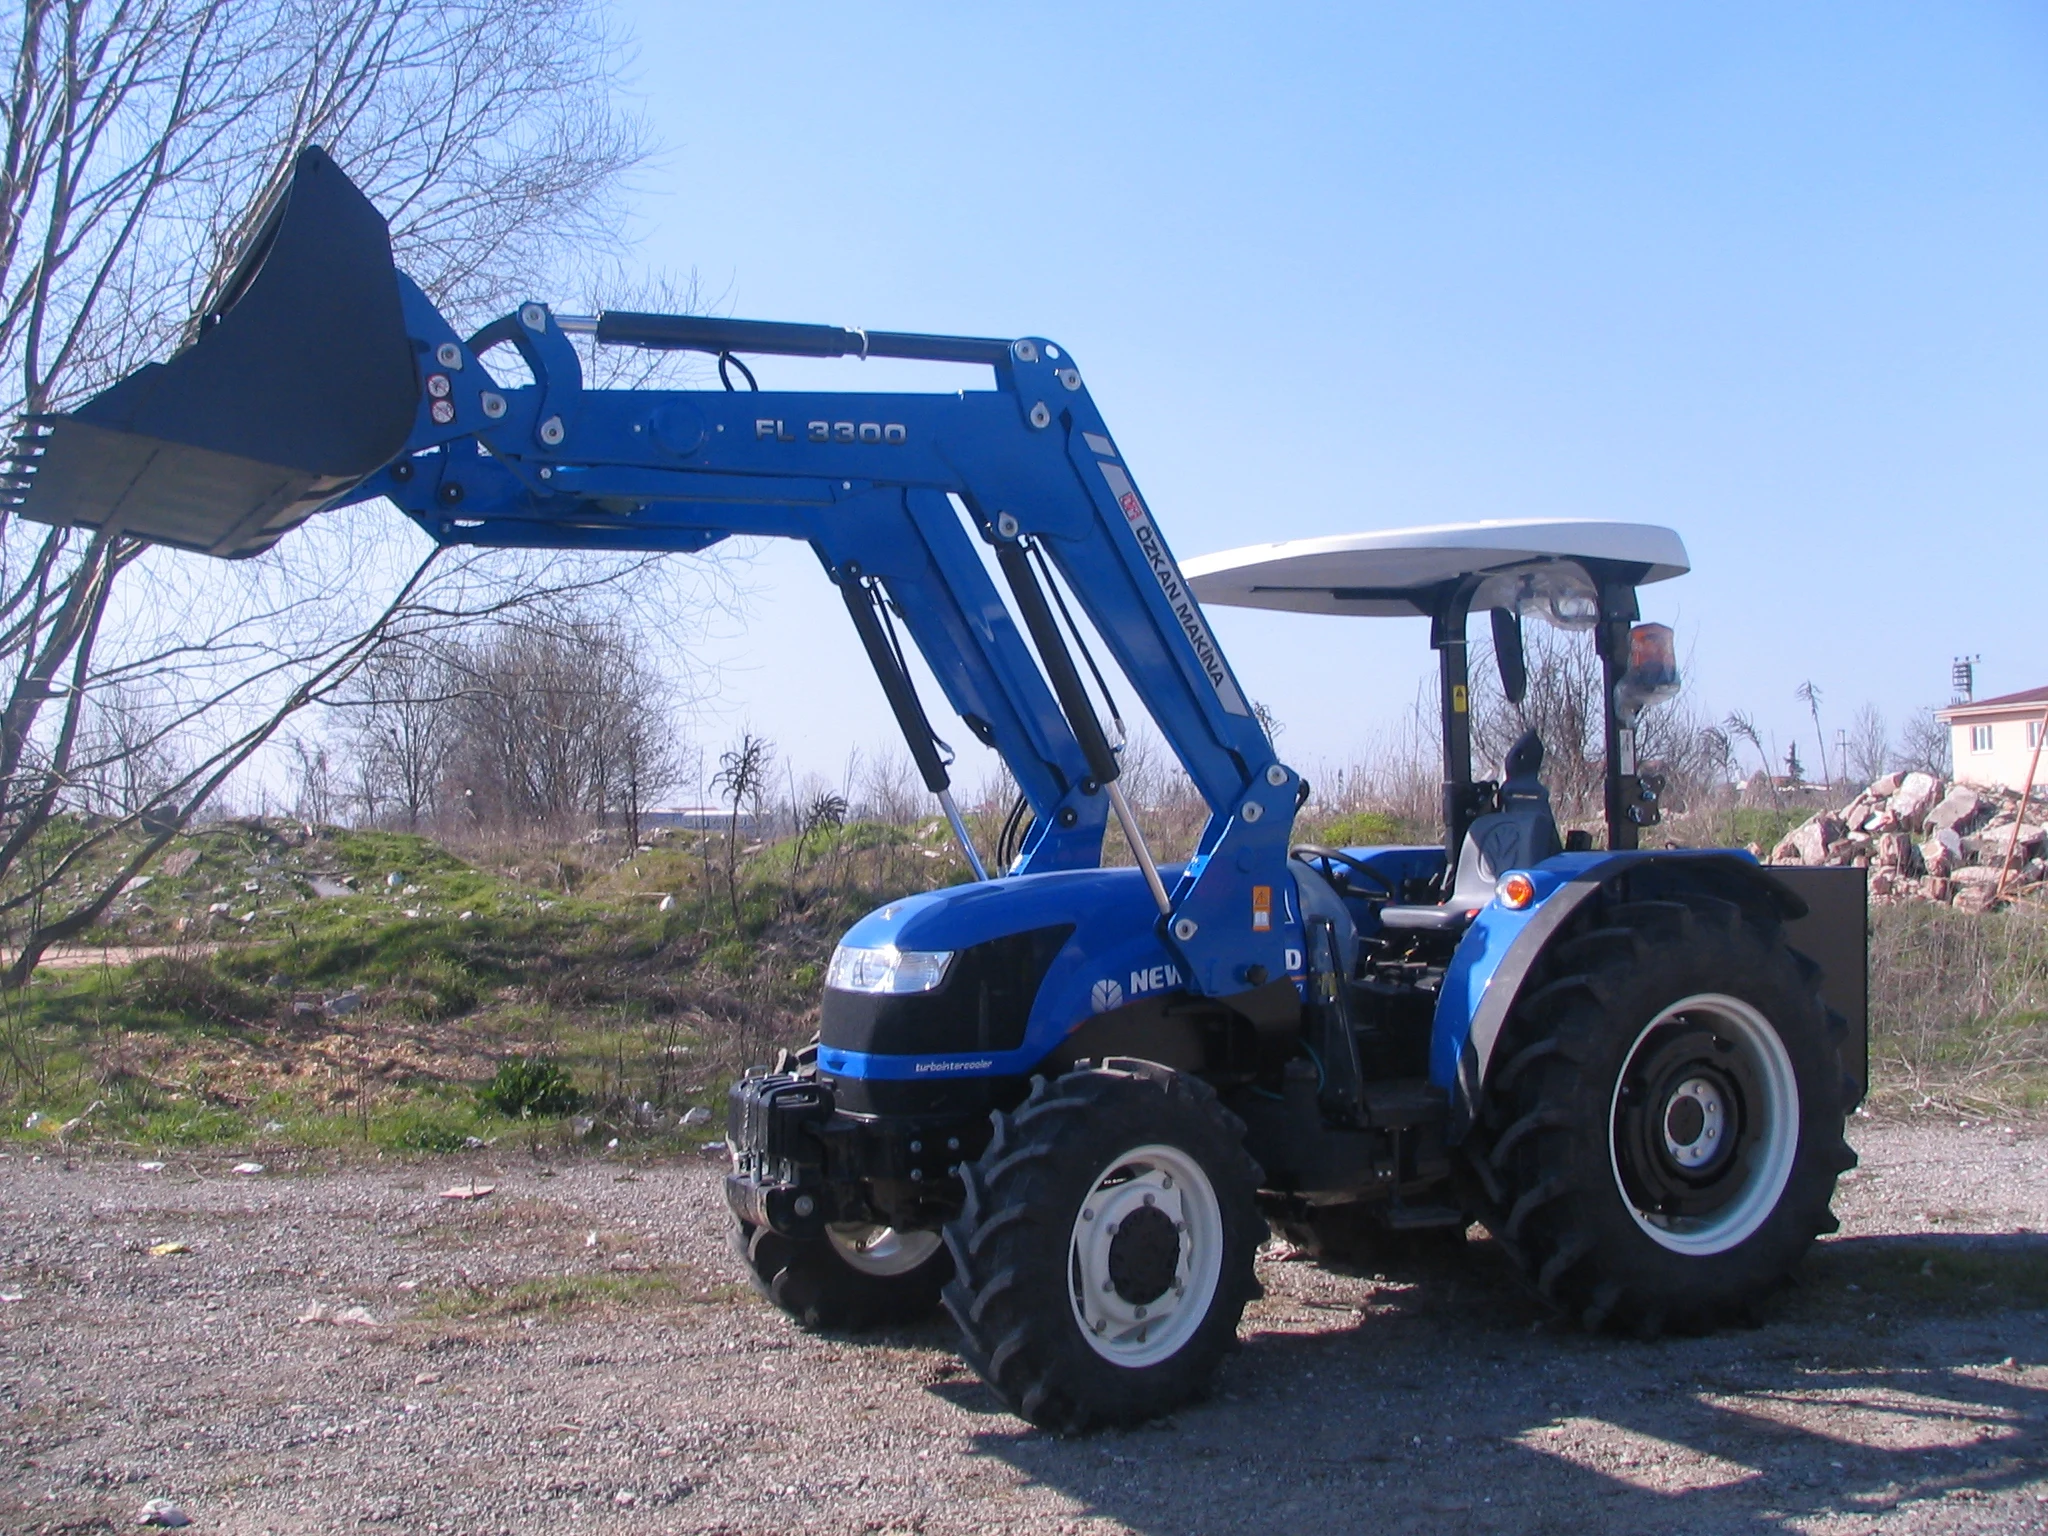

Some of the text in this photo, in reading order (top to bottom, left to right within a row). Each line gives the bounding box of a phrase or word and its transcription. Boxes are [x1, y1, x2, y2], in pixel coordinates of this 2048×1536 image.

[755, 419, 907, 445] FL 3300
[1136, 526, 1181, 601] ÖZKAN
[1130, 964, 1183, 995] NEW
[915, 1059, 993, 1073] turbointercooler
